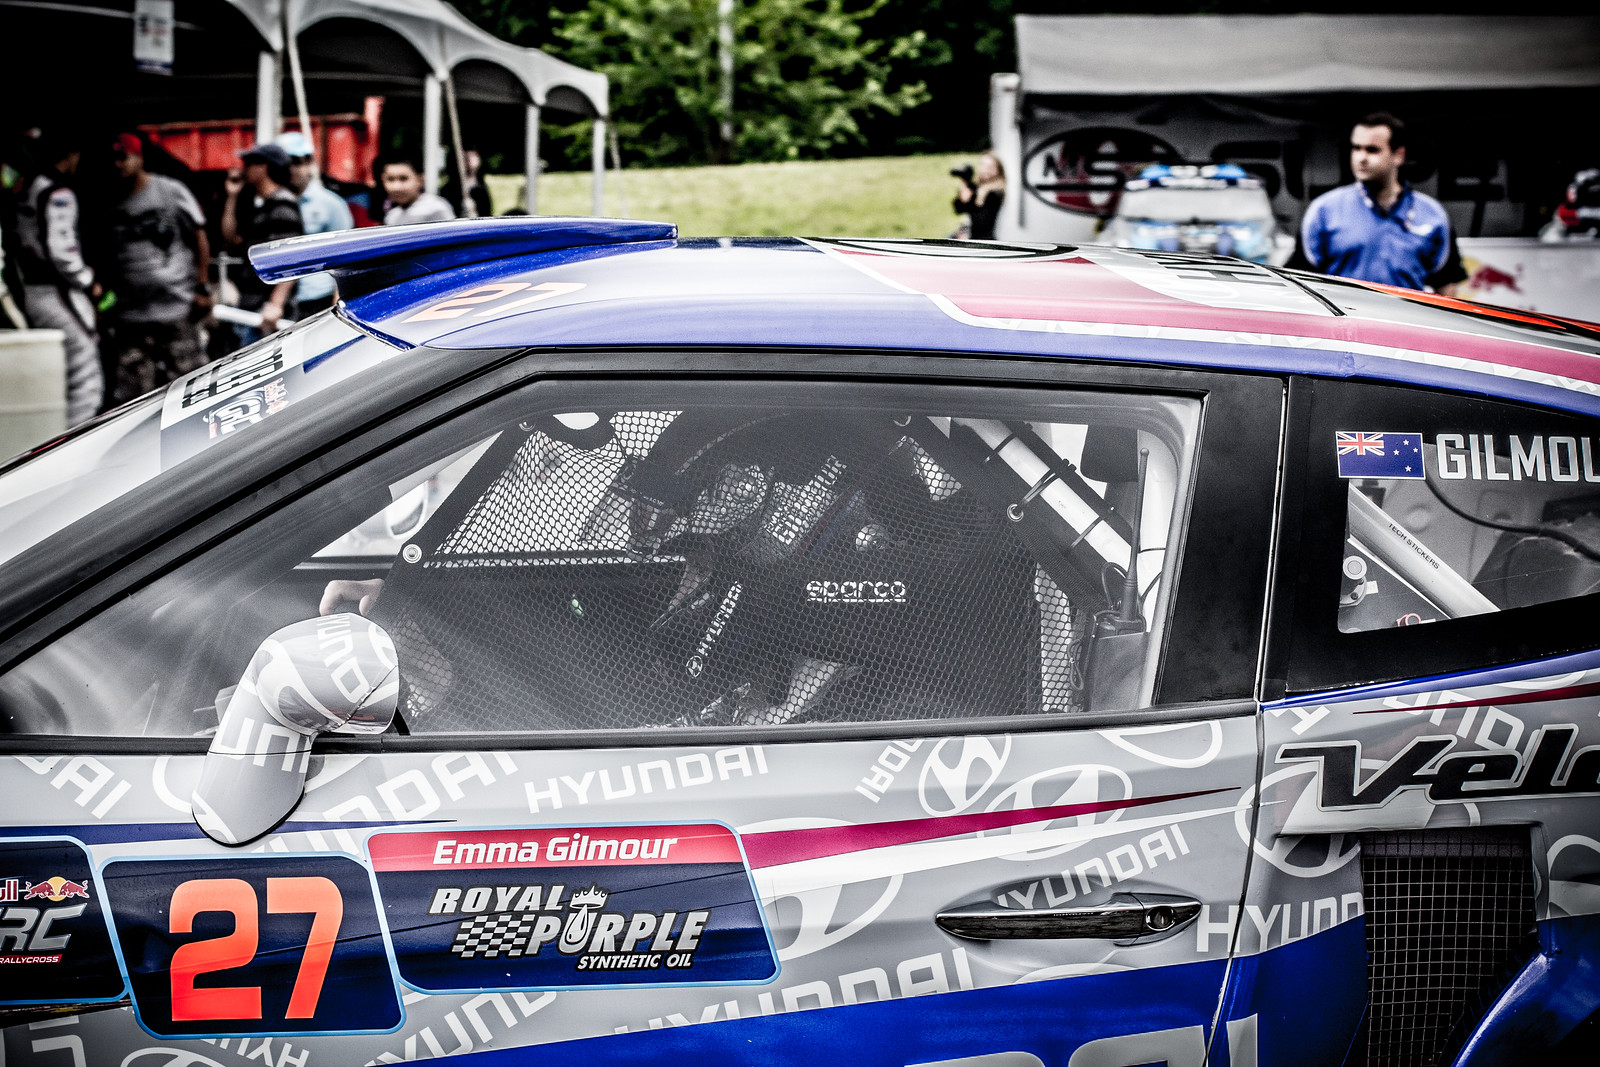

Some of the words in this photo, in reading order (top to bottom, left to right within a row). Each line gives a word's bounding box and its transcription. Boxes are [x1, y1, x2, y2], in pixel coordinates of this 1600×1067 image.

[401, 281, 588, 324] 27
[1389, 523, 1407, 541] TECH
[1406, 537, 1440, 570] STICKERS
[806, 580, 906, 603] sparco
[524, 745, 769, 814] HYUNDAI
[433, 839, 539, 865] Emma
[546, 832, 678, 862] Gilmour
[429, 885, 565, 914] ROYAL
[169, 876, 344, 1021] 27
[525, 911, 709, 957] PURPLE
[577, 953, 662, 970] SYNTHETIC
[666, 953, 692, 968] OIL
